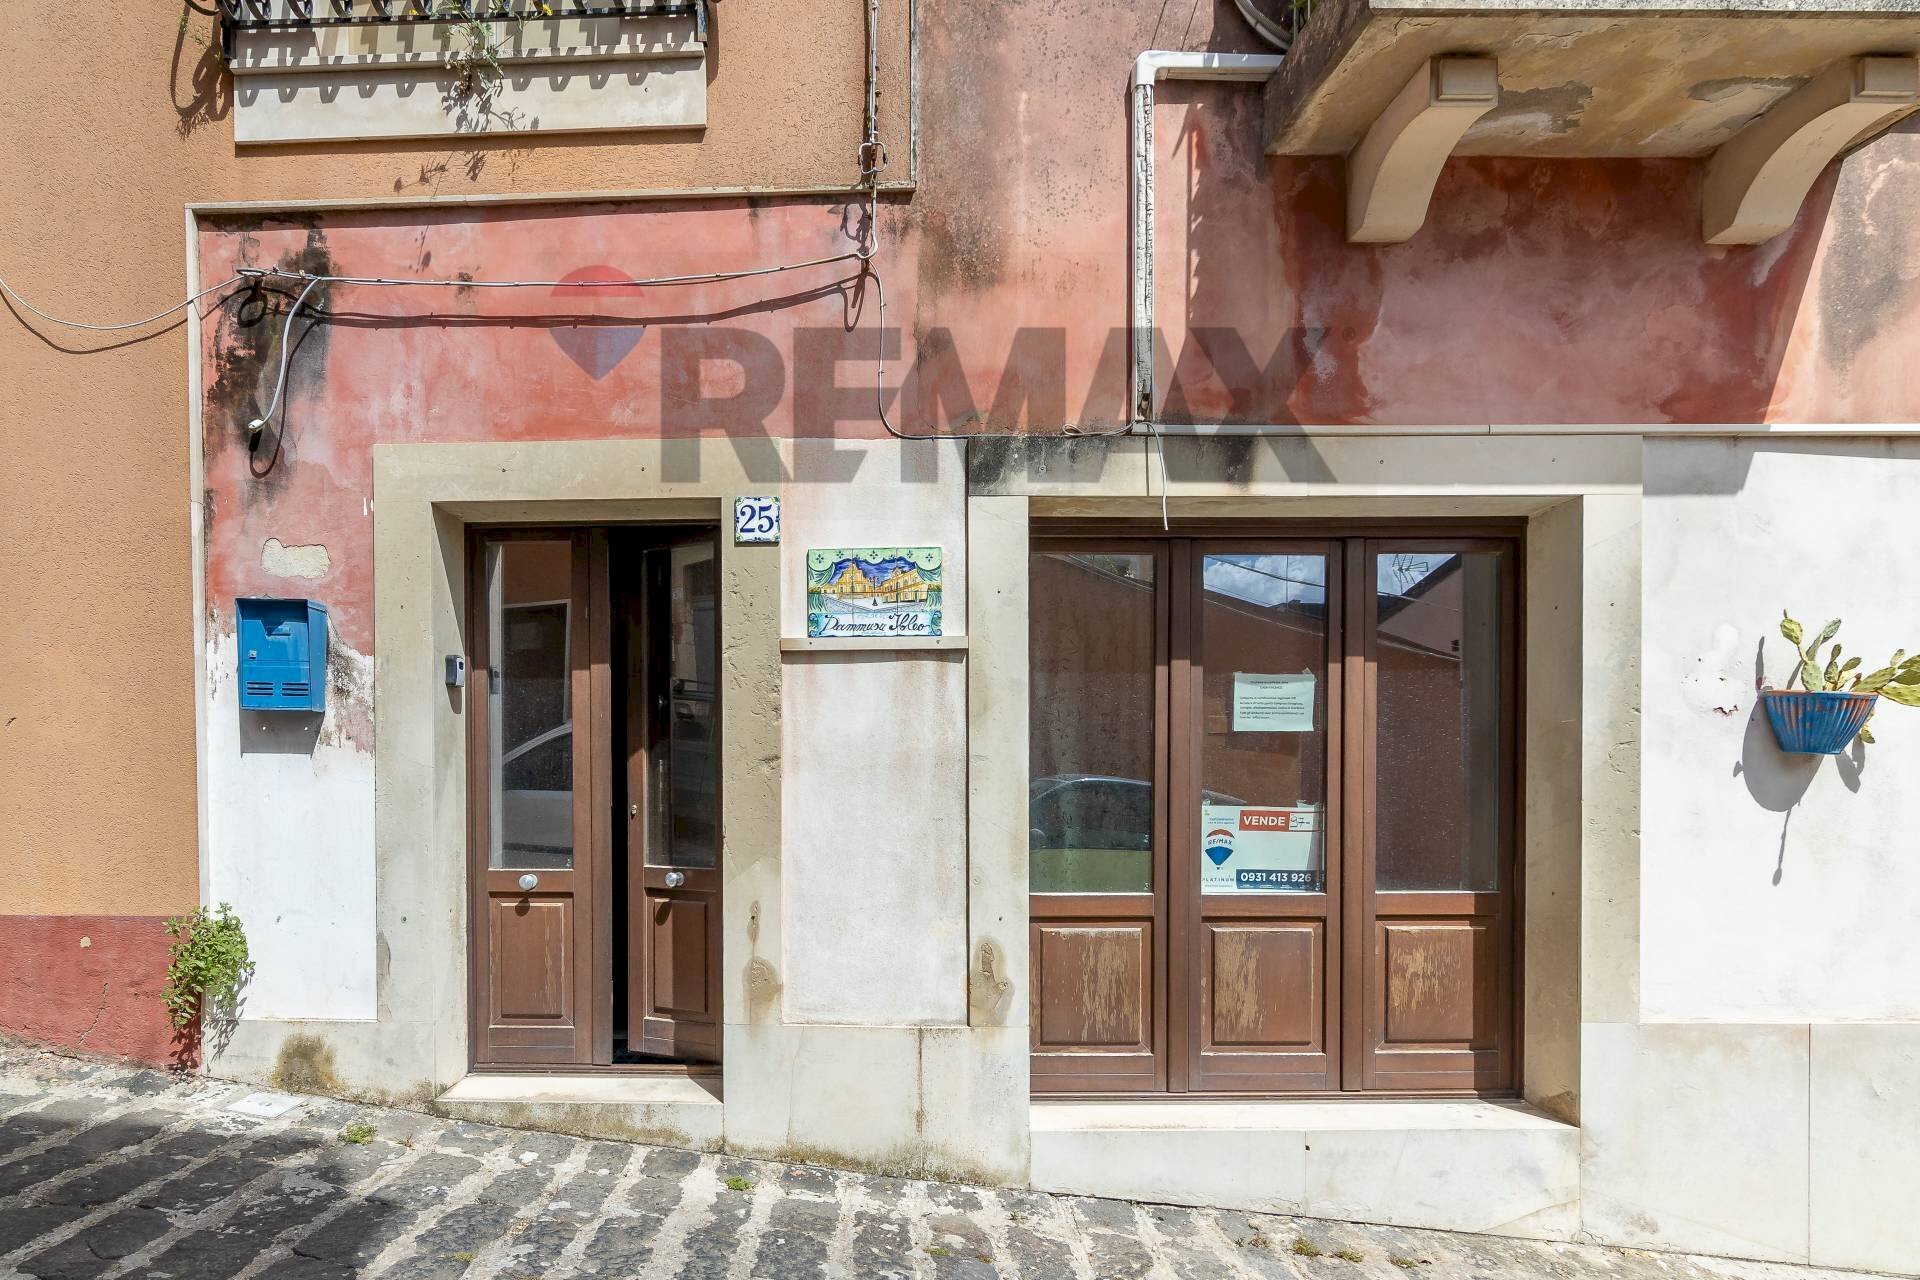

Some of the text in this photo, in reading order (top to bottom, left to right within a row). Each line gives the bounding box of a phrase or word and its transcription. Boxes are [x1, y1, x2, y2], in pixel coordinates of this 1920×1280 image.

[739, 504, 775, 533] 25
[888, 613, 931, 632] Ibleo
[1243, 815, 1286, 826] VENDE
[1240, 872, 1312, 882] 0931 413 926
